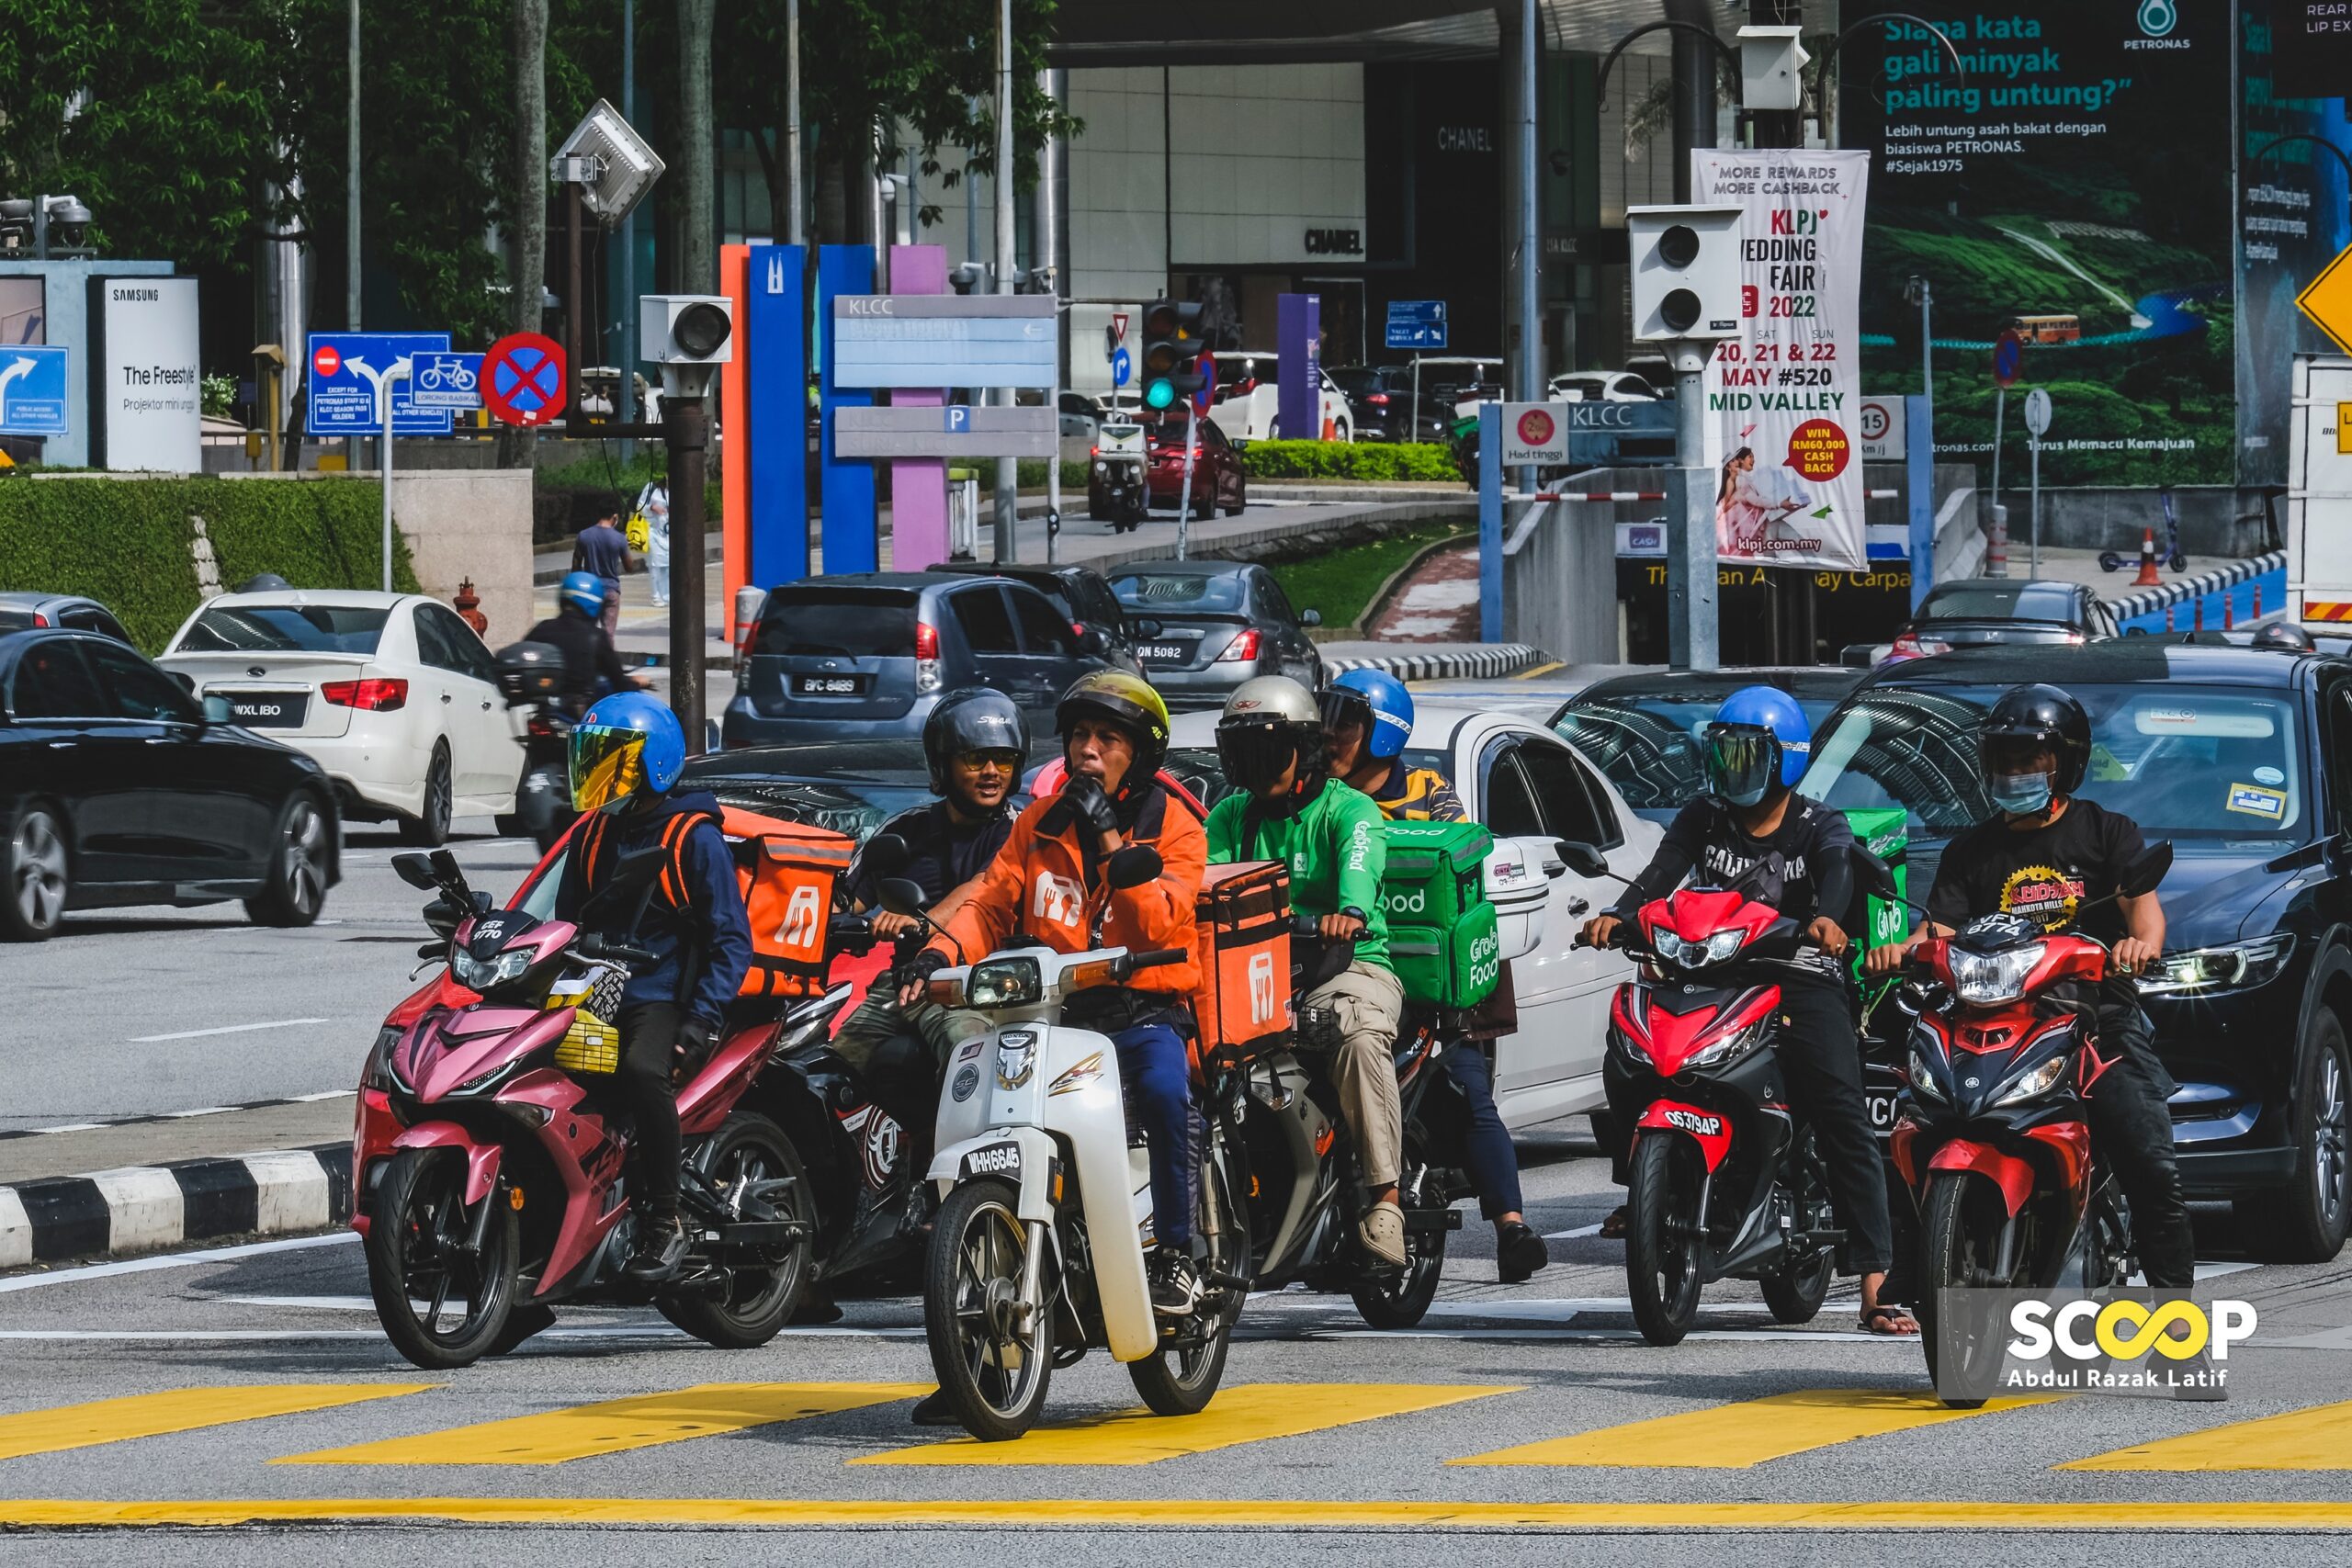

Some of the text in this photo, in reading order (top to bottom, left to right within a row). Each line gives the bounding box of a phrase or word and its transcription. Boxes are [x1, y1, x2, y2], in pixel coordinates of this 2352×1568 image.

[2307, 4, 2346, 16] REAR
[1975, 15, 2041, 39] kata
[2307, 21, 2329, 33] LIP
[2123, 39, 2190, 50] PETRONAS
[1884, 47, 2060, 82] gali minyak
[1884, 82, 1981, 115] paling
[1885, 121, 2107, 138] Lebih untung asah bakat dengan
[1437, 126, 1493, 152] CHANEL
[1885, 140, 2025, 154] biasiswa PETRONAS.
[1719, 166, 1838, 179] MORE REWARDS
[1885, 159, 1963, 175] #Sejak1975
[1713, 182, 1841, 195] MORE CASHBACK
[1770, 209, 1818, 235] KLPJ
[1304, 228, 1364, 254] CHANEL
[1770, 265, 1815, 291] FAIR
[113, 288, 159, 301] SAMSUNG
[849, 299, 893, 314] KLCC
[1770, 295, 1815, 318] 2022
[1757, 329, 1835, 340] SAT SUN
[1754, 344, 1779, 362] 21
[1787, 344, 1804, 362] &
[1810, 343, 1836, 361] 22
[123, 366, 151, 386] The
[1722, 367, 1832, 387] MAY #520
[123, 397, 164, 414] Projektor
[1709, 392, 1845, 412] MID VALLEY
[950, 409, 965, 430] P
[1572, 405, 1633, 426] KLCC
[1860, 414, 1883, 430] 15
[1806, 428, 1830, 438] WIN
[1792, 440, 1846, 451] RM60,000
[2067, 440, 2123, 451] Memacu
[2127, 438, 2195, 452] Kemajuan
[1508, 449, 1564, 462] Had tinggi
[1804, 452, 1834, 462] CASH
[1804, 463, 1835, 473] BACK
[1737, 536, 1822, 552] klpj.com.my
[1849, 570, 1911, 591] Carpa
[233, 705, 281, 716] WXL 180
[472, 929, 503, 942] 9770
[1470, 925, 1498, 963] Grab
[1470, 950, 1498, 990] Food
